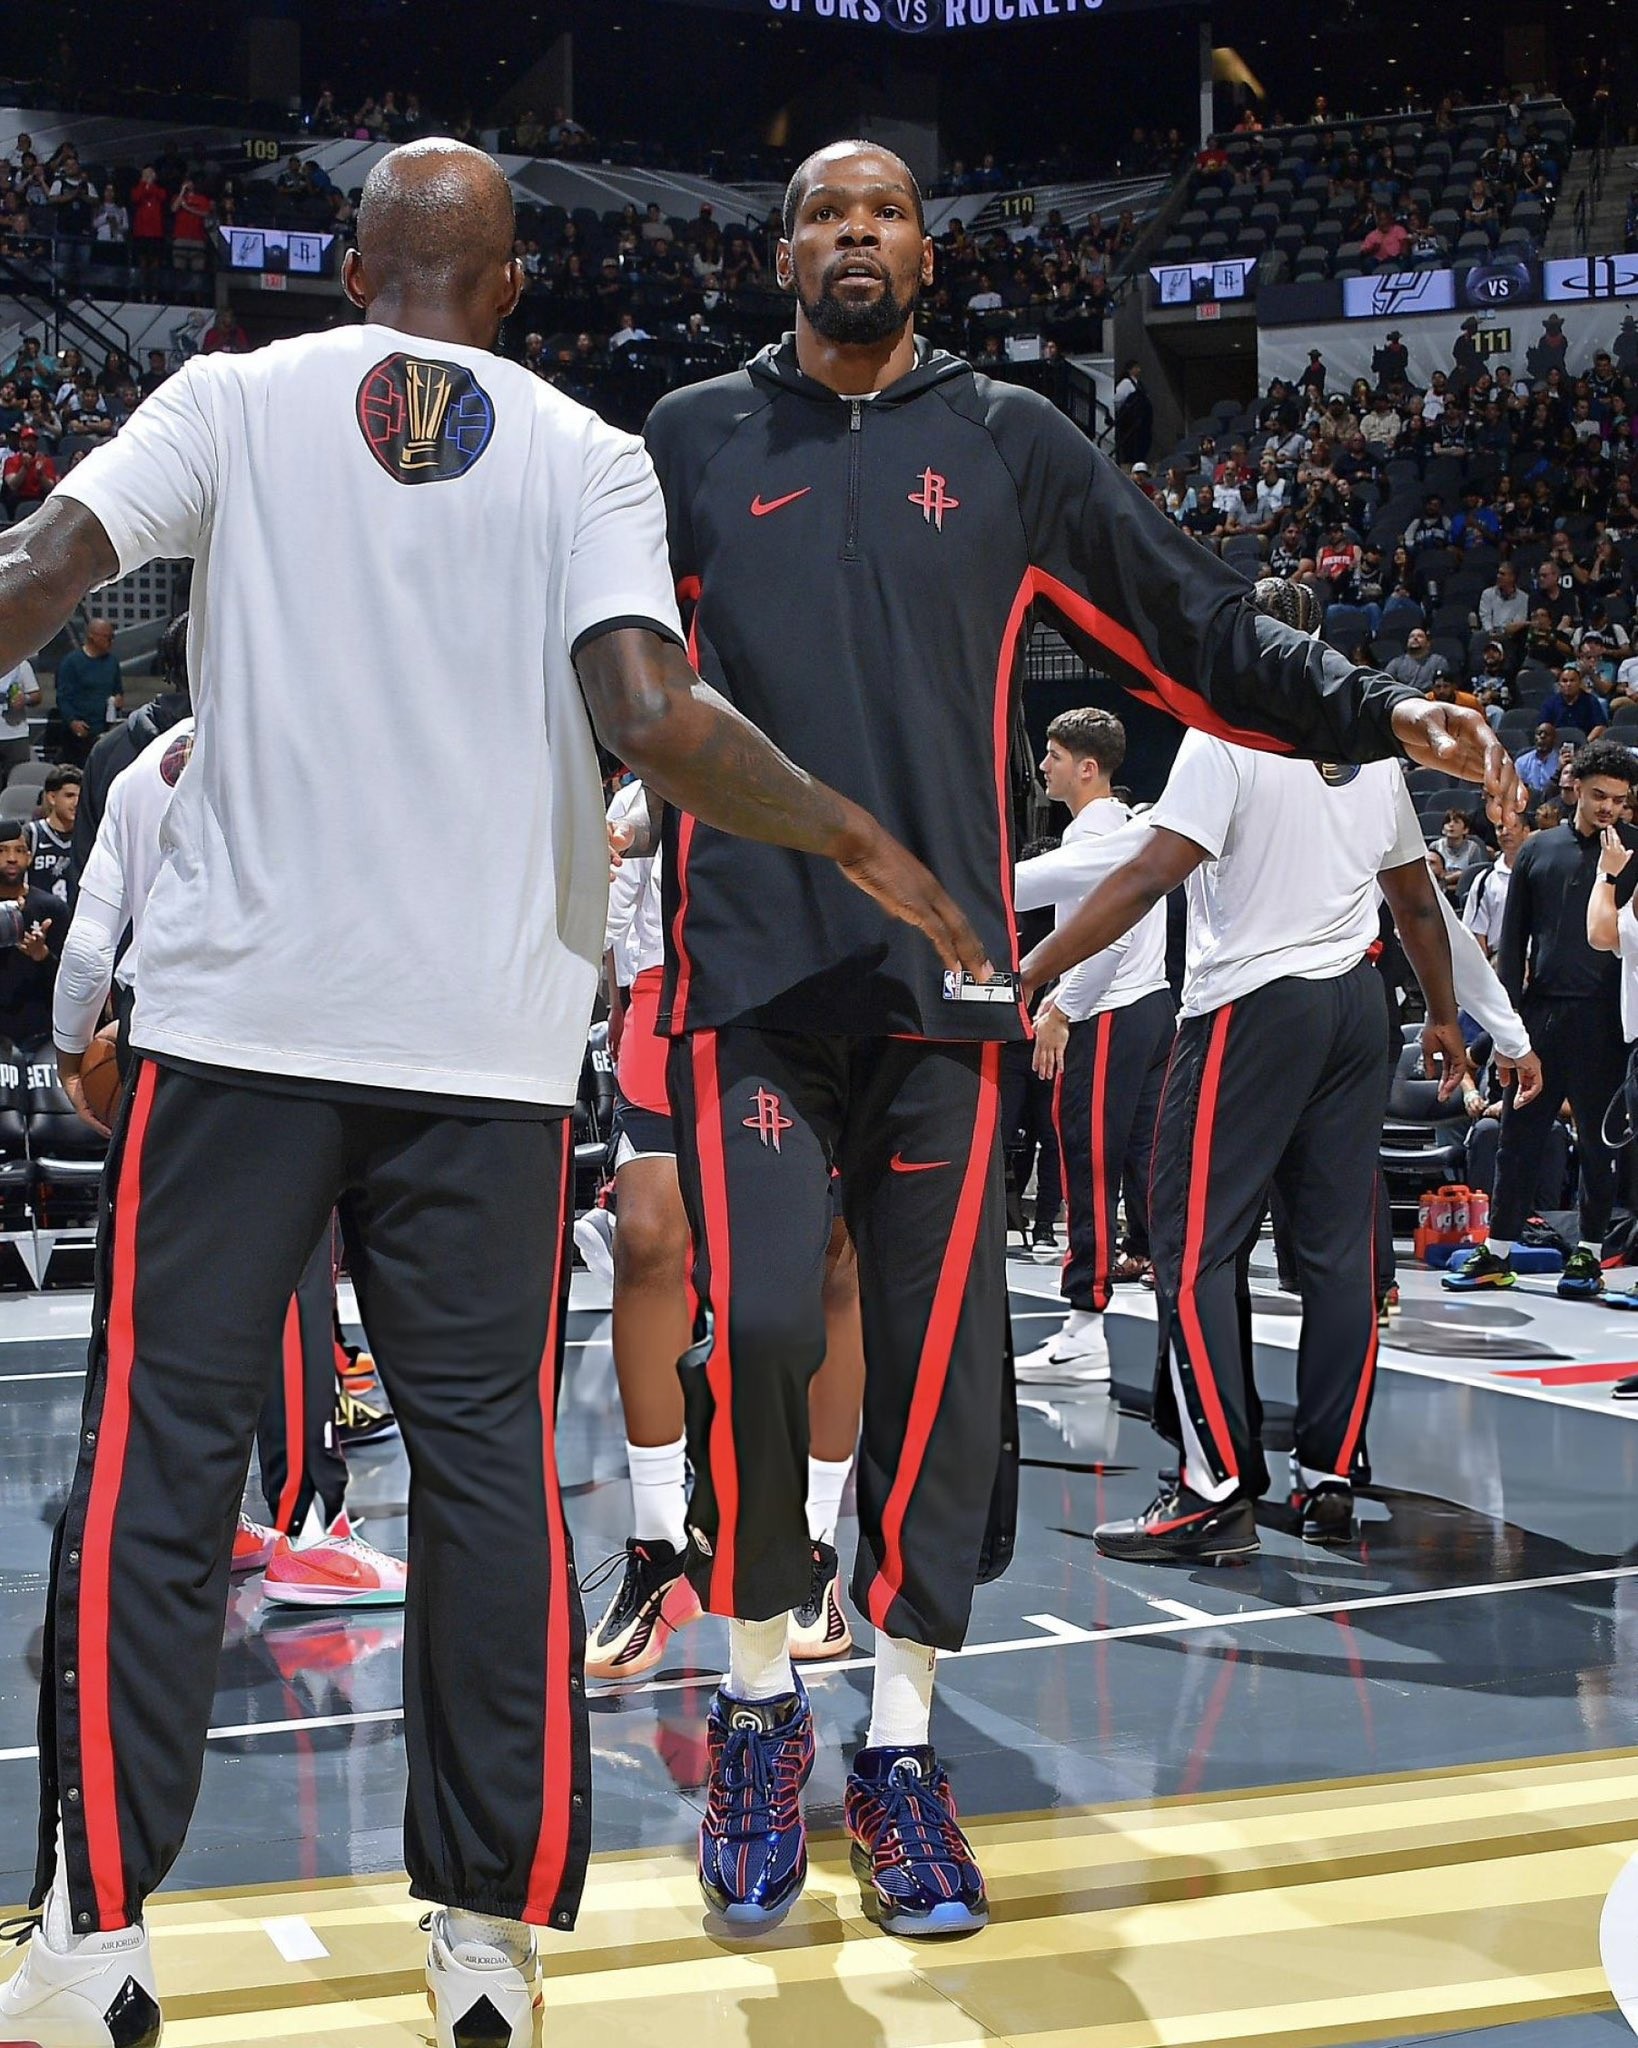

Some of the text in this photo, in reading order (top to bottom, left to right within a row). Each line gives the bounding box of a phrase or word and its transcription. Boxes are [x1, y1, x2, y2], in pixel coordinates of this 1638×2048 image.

[897, 0, 927, 24] VS
[243, 139, 279, 160] 109
[1487, 278, 1509, 297] VS
[1471, 329, 1509, 353] 111
[984, 988, 995, 1001] 7
[101, 1942, 114, 1950] AIR
[465, 1956, 508, 1965] AIR JORDAN
